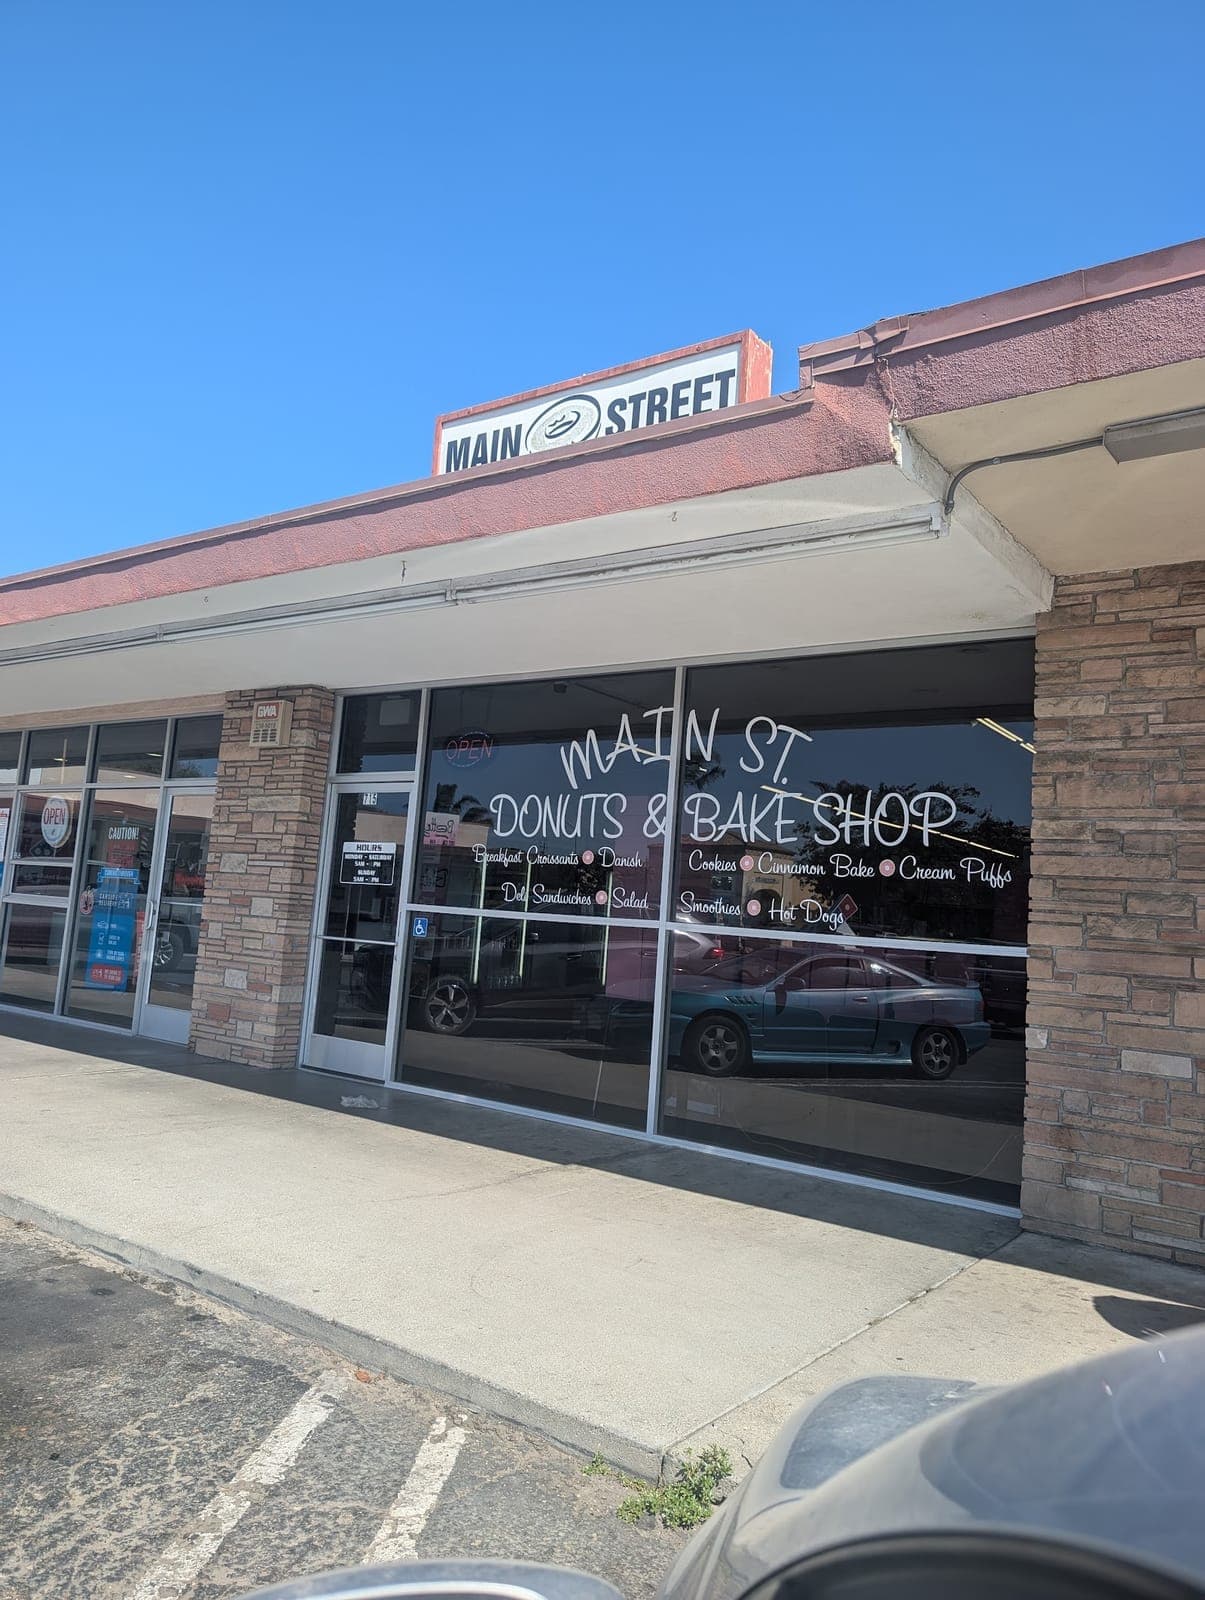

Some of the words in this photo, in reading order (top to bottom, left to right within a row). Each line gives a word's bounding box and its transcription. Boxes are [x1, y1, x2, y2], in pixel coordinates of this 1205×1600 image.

[446, 423, 522, 473] MAIN
[605, 368, 736, 435] STREET
[446, 739, 494, 760] OPEN
[560, 706, 720, 789] MAIN
[739, 716, 813, 785] ST.
[43, 808, 66, 825] OPEN
[489, 793, 628, 838] DONUTS
[642, 793, 668, 838] &
[684, 791, 803, 843] BAKE
[812, 790, 958, 847] SHOP
[108, 827, 140, 840] CAUTION!
[472, 843, 523, 867] Breakfast
[526, 845, 579, 867] Croissants
[598, 847, 643, 868] Danish
[689, 849, 737, 872] Cookies
[758, 851, 827, 877] Cinnamon
[829, 853, 876, 878] Bake
[899, 855, 956, 881] Cream
[959, 857, 1012, 889] Puffs
[532, 883, 592, 906] Sandwiches
[612, 887, 649, 909] Salad
[680, 891, 741, 916] Smoothies
[768, 898, 798, 922] Hot
[800, 899, 845, 931] Dogs
